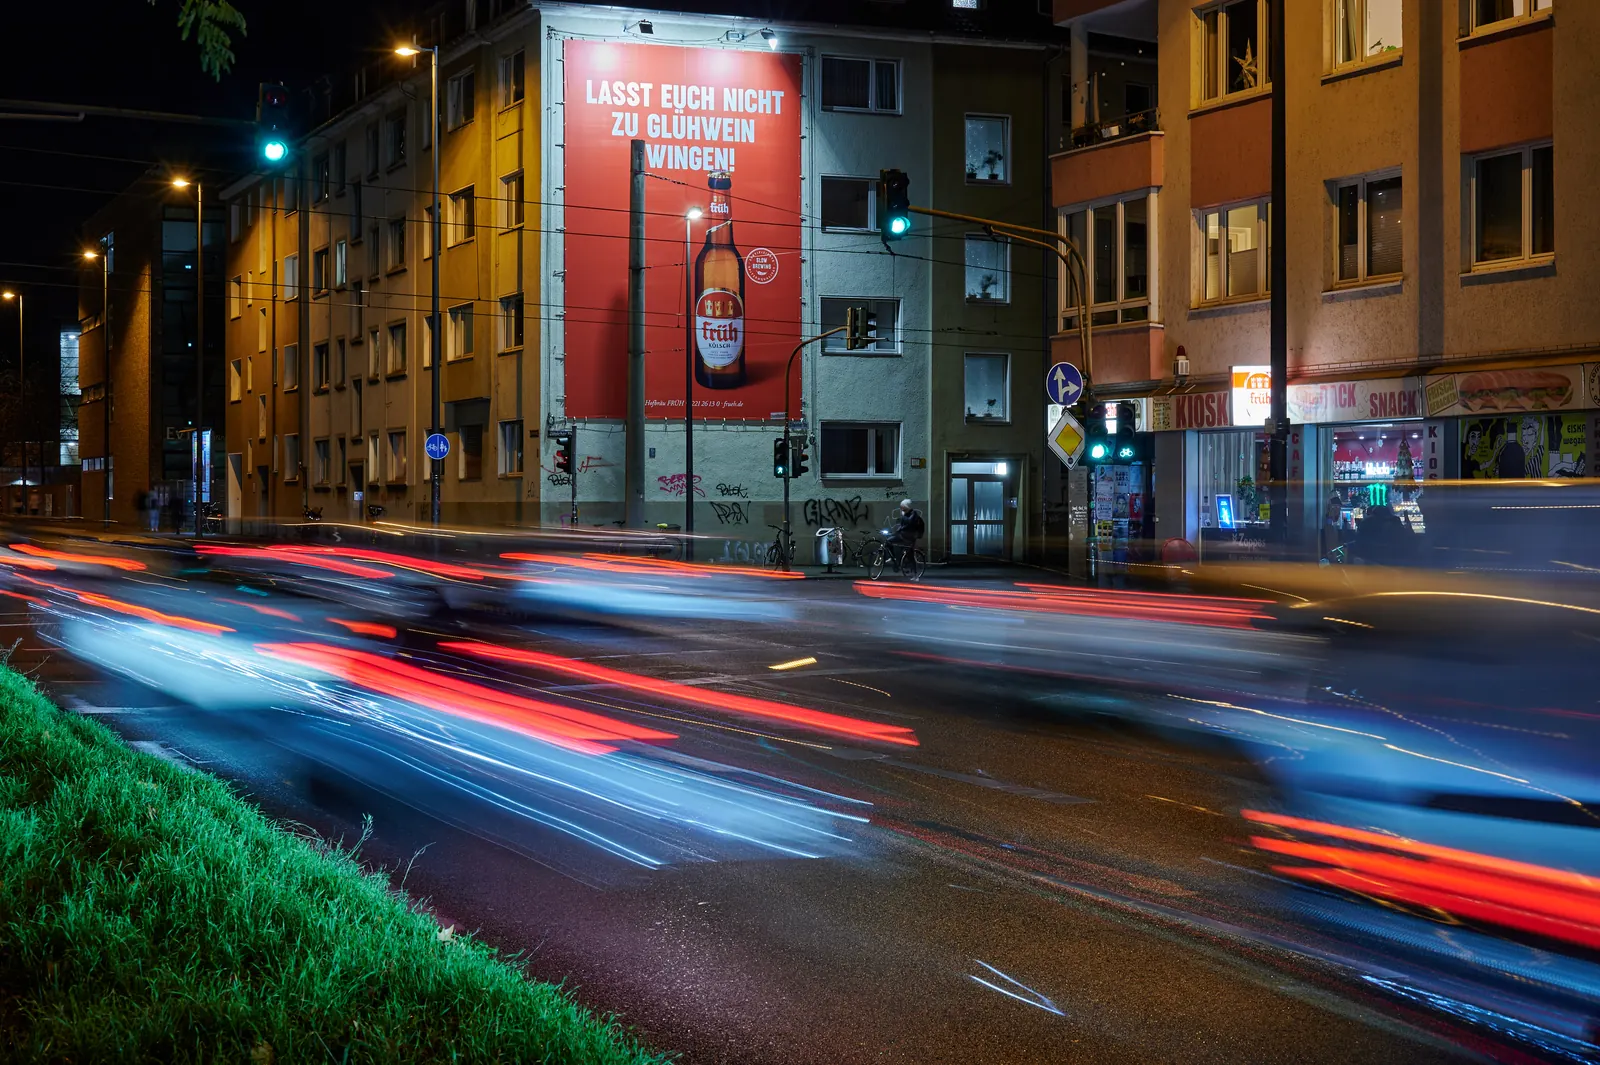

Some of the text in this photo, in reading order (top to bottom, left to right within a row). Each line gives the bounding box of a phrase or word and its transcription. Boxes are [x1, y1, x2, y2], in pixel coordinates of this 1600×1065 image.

[586, 79, 784, 115] LASST EUCH NICHT
[611, 109, 755, 143] ZU GLÜHWEIN
[645, 144, 735, 172] WINGEN!
[710, 202, 729, 214] früh
[702, 321, 738, 342] früh
[667, 399, 685, 407] FRÜH
[1176, 391, 1230, 429] KIOSK
[1250, 391, 1272, 405] früh
[1369, 390, 1417, 418] SNACK
